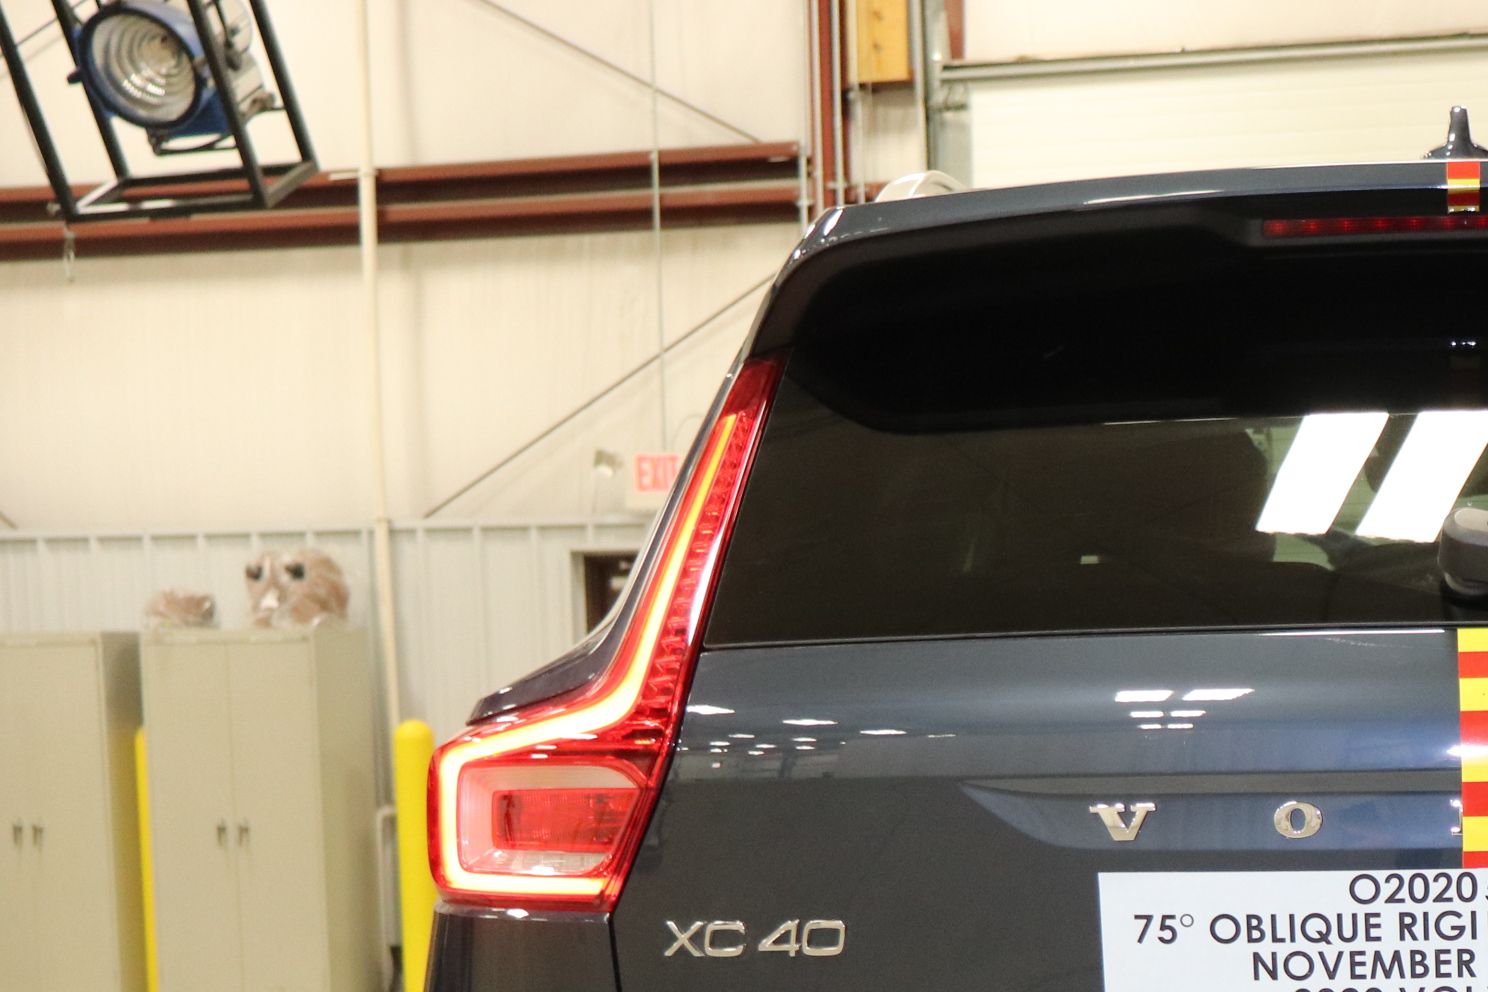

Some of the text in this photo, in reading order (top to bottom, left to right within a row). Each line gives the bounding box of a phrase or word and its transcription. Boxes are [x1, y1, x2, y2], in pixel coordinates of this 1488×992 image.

[1133, 913, 1194, 945] 75°
[1209, 912, 1382, 945] OBLIQUE
[1252, 948, 1477, 982] NOVEMBER
